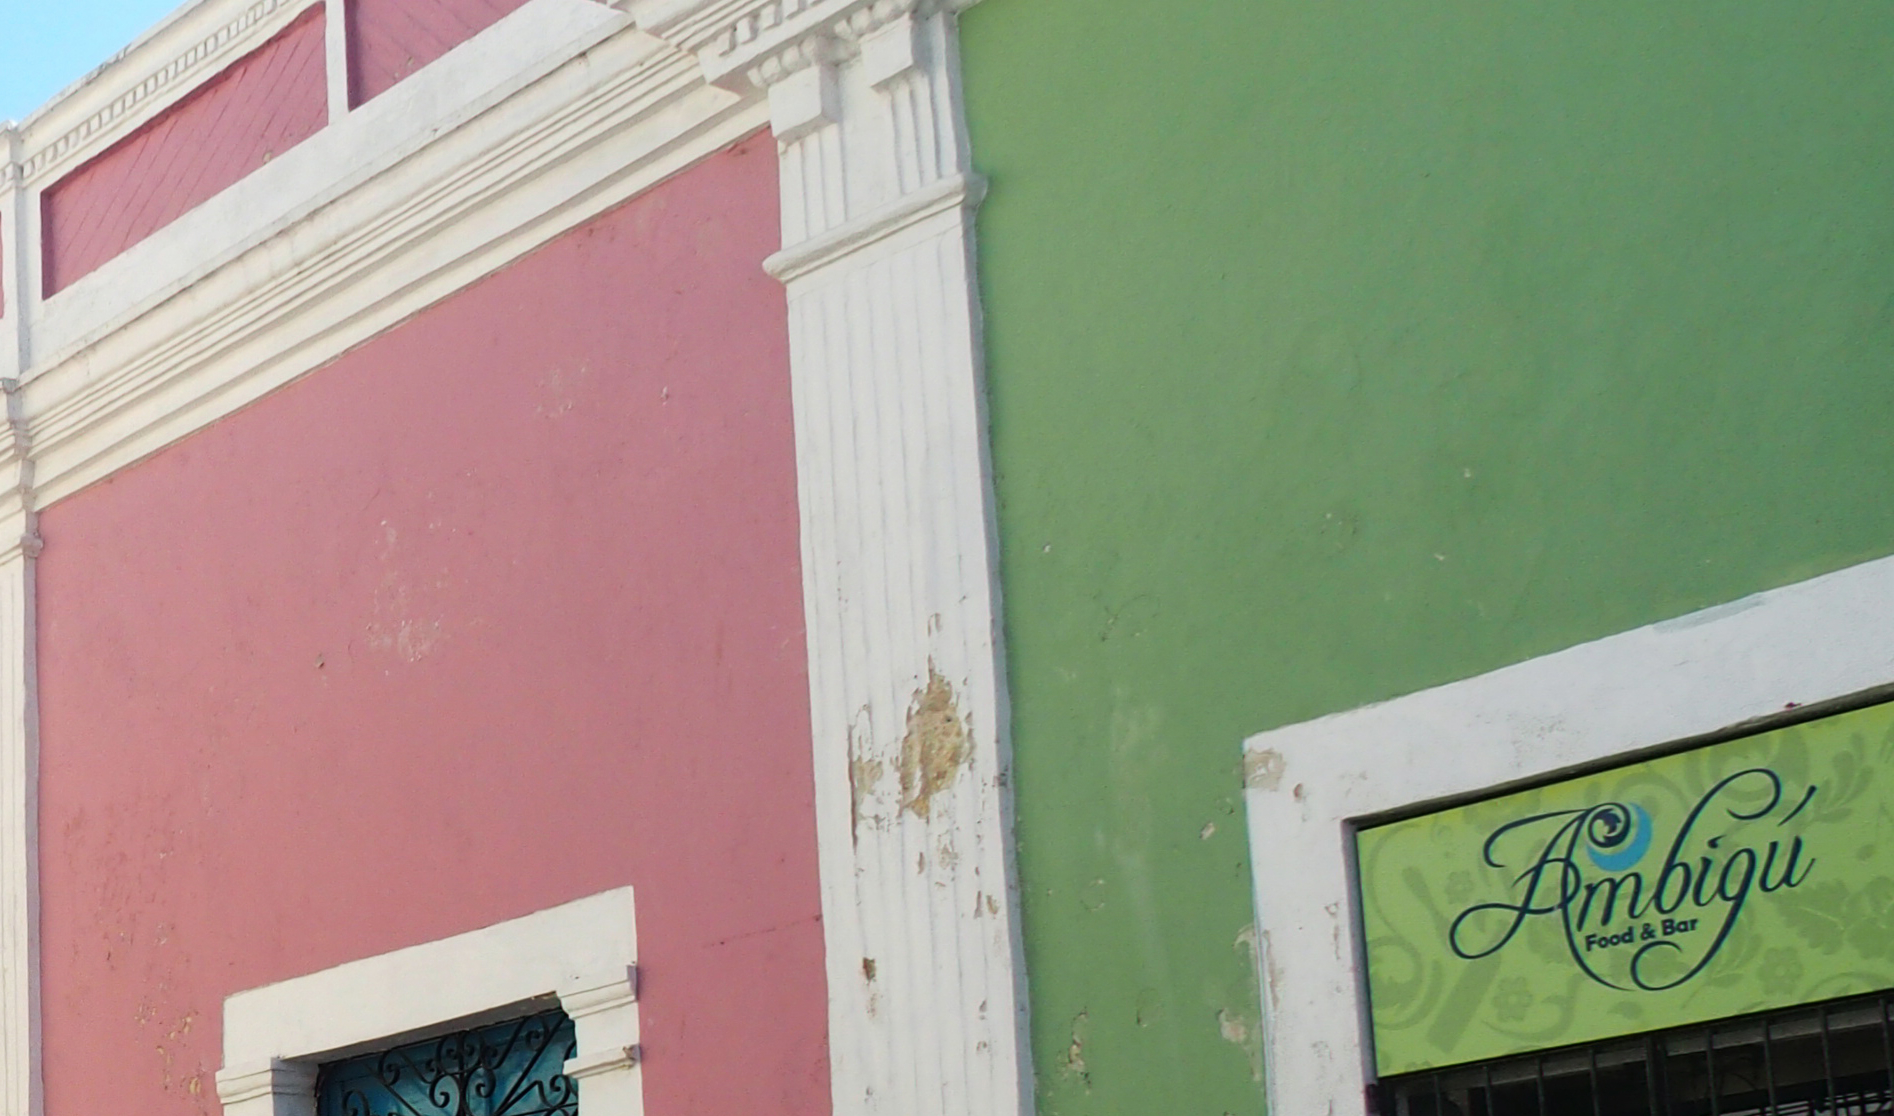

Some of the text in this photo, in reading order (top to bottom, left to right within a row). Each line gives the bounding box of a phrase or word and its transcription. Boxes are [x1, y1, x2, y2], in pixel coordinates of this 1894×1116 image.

[1449, 768, 1818, 991] Ambigú
[1585, 915, 1699, 952] Food & Bar
